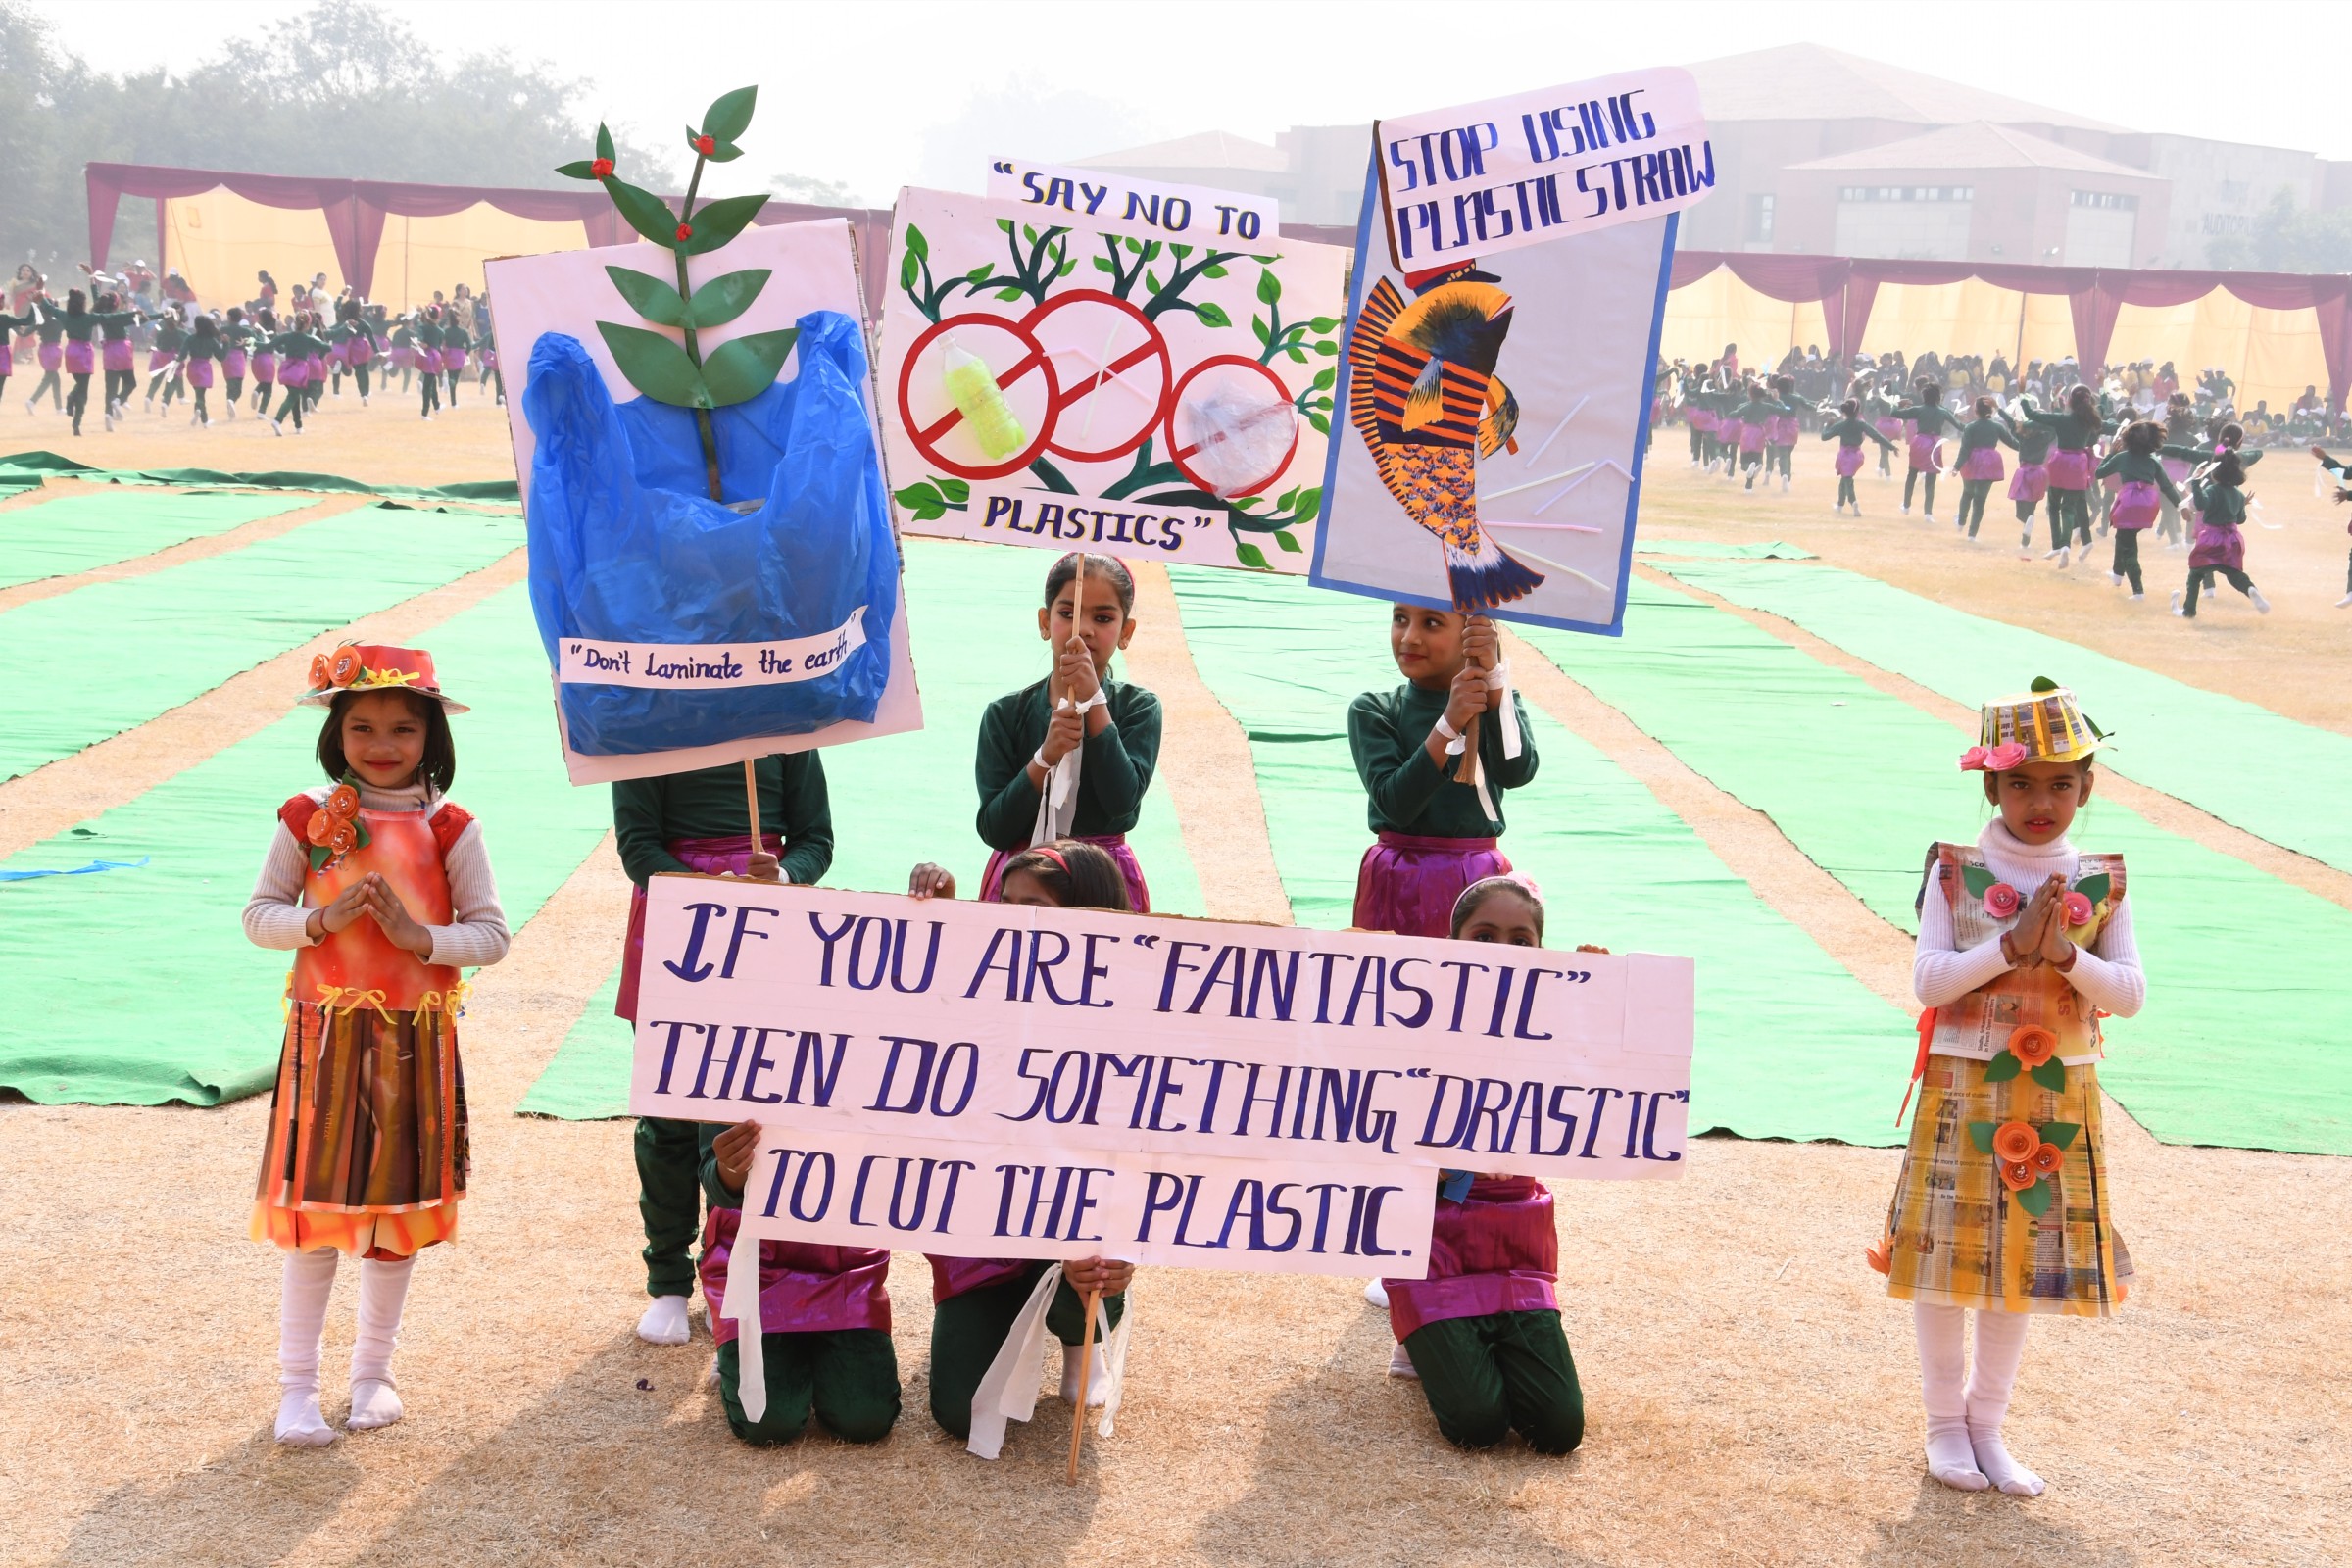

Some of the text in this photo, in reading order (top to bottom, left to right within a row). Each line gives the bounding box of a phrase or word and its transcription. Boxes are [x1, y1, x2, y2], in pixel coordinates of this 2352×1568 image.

[1390, 89, 1656, 192] STOP USING
[993, 161, 1261, 240] "SAY NO TO
[1393, 140, 1716, 259] PLASTIC STRAW
[981, 495, 1213, 552] PLASTICS"
[758, 650, 792, 675] the
[662, 903, 1591, 1041] IF YOU ARE "FANTASTIC"
[649, 1021, 854, 1108] THEN
[862, 1036, 979, 1116] DO
[993, 1049, 1402, 1154] SOMETHING
[761, 1149, 1412, 1257] TO CUT THE PLASTIC.
